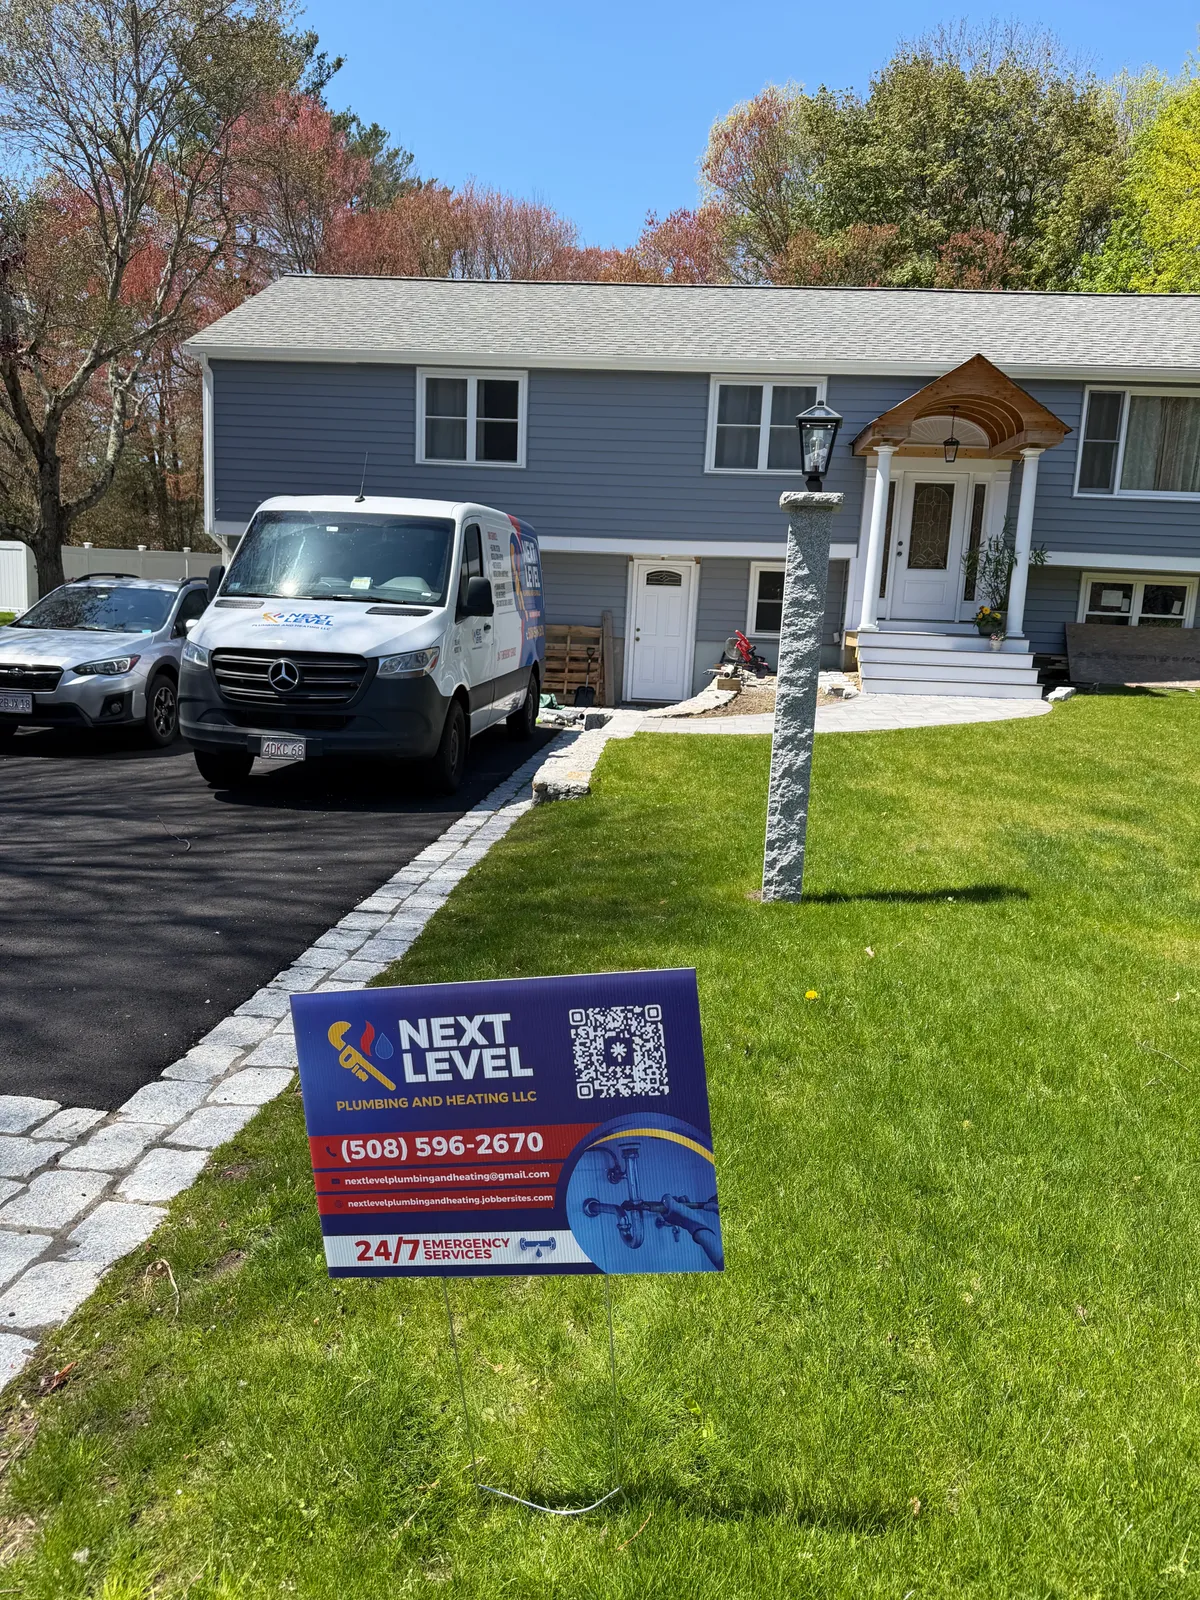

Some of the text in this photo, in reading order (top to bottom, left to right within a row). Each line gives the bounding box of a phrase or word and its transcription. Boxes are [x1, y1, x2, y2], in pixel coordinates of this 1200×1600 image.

[525, 564, 540, 588] LEVEL
[284, 618, 334, 626] LEVEL
[20, 699, 30, 709] 18
[264, 743, 303, 756] 4DKC 68
[398, 1013, 511, 1050] NEXT
[402, 1046, 534, 1083] LEVEL
[336, 1090, 537, 1112] PLUMBING AND HEATING LLC
[341, 1132, 544, 1163] (508) 596-2670
[344, 1170, 550, 1187] nextlevelplumbingandheating@gmail.com
[347, 1193, 553, 1209] nextlevelplumbingandheating.jobbersites.com
[354, 1236, 510, 1264] 24/7 EMERGENCY
[424, 1249, 492, 1260] SERVICES
